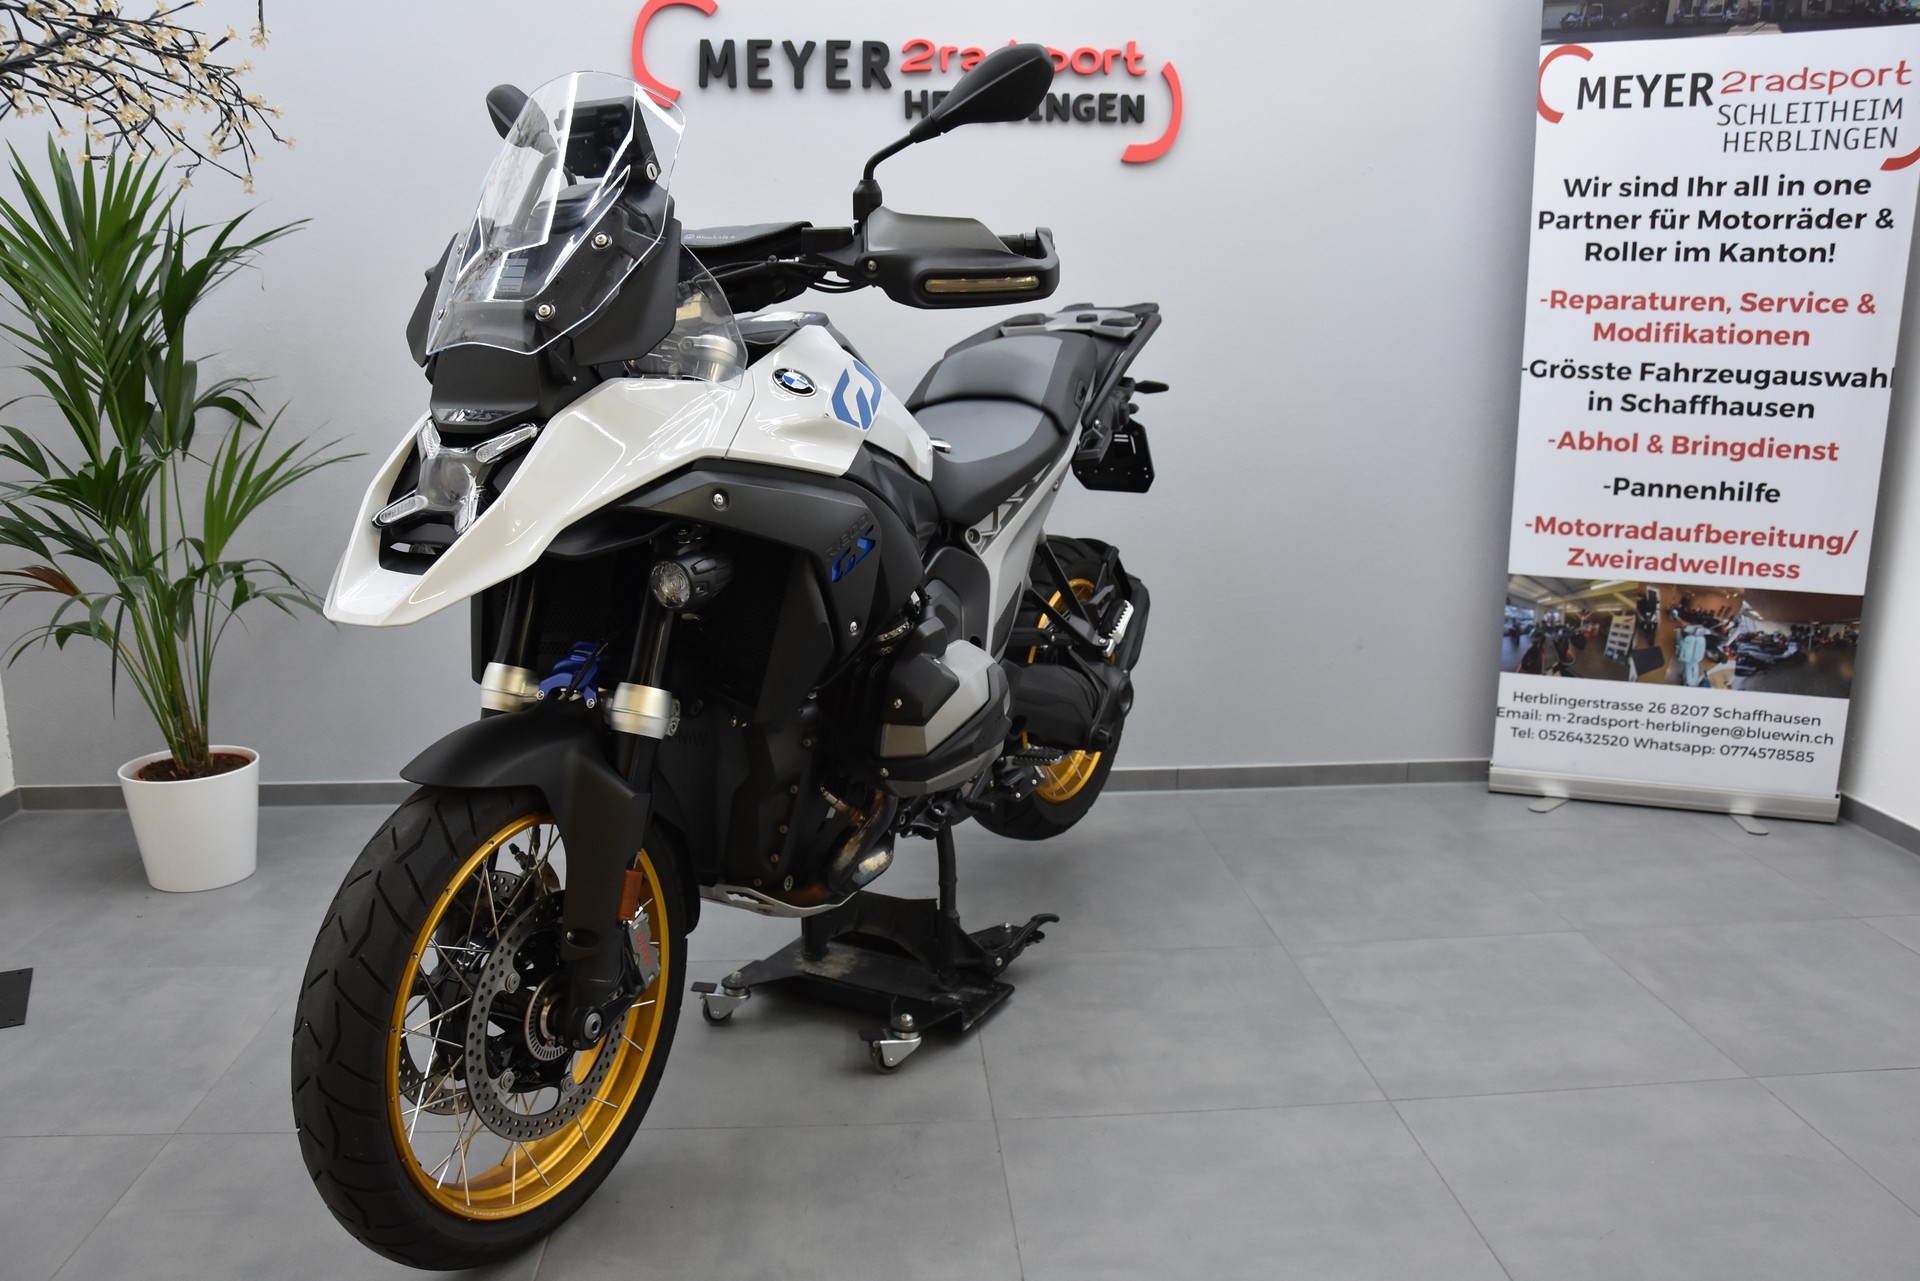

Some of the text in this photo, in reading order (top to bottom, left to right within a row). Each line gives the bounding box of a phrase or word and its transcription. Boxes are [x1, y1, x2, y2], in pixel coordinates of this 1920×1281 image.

[698, 39, 1147, 89] MEYER 2raport
[1576, 59, 1912, 110] MEYER 2radsport
[1717, 96, 1903, 127] SCHLEITHEIM
[1723, 126, 1898, 153] HERBLINGEN
[1563, 173, 1872, 198] Wir sind Ihr all in one
[1538, 207, 1894, 230] Partner für Motorräder &
[1584, 240, 1836, 264] Roller im Kanton!
[1540, 289, 1876, 315] -Reparaturen, Service &
[1593, 322, 1810, 346] Modifikationen
[1521, 358, 1632, 381] -Grösste
[1588, 390, 1815, 419] in Schaffhausen
[1548, 430, 1839, 462] -Abhol & Bringdienst
[1603, 476, 1781, 503] -Pannenhilfe
[1525, 514, 1858, 555] -Motorradaufbereitung/
[1567, 547, 1800, 579] Zweiradwellness
[1512, 690, 1822, 727] Herblingerstrasse 26 8207 Schaffhausen
[1496, 706, 1834, 745] Email: m-2radsport-herblingen@bluewin.ch
[1510, 726, 1815, 763] Tel: 0526432520 Whatsapp: 0774578585
